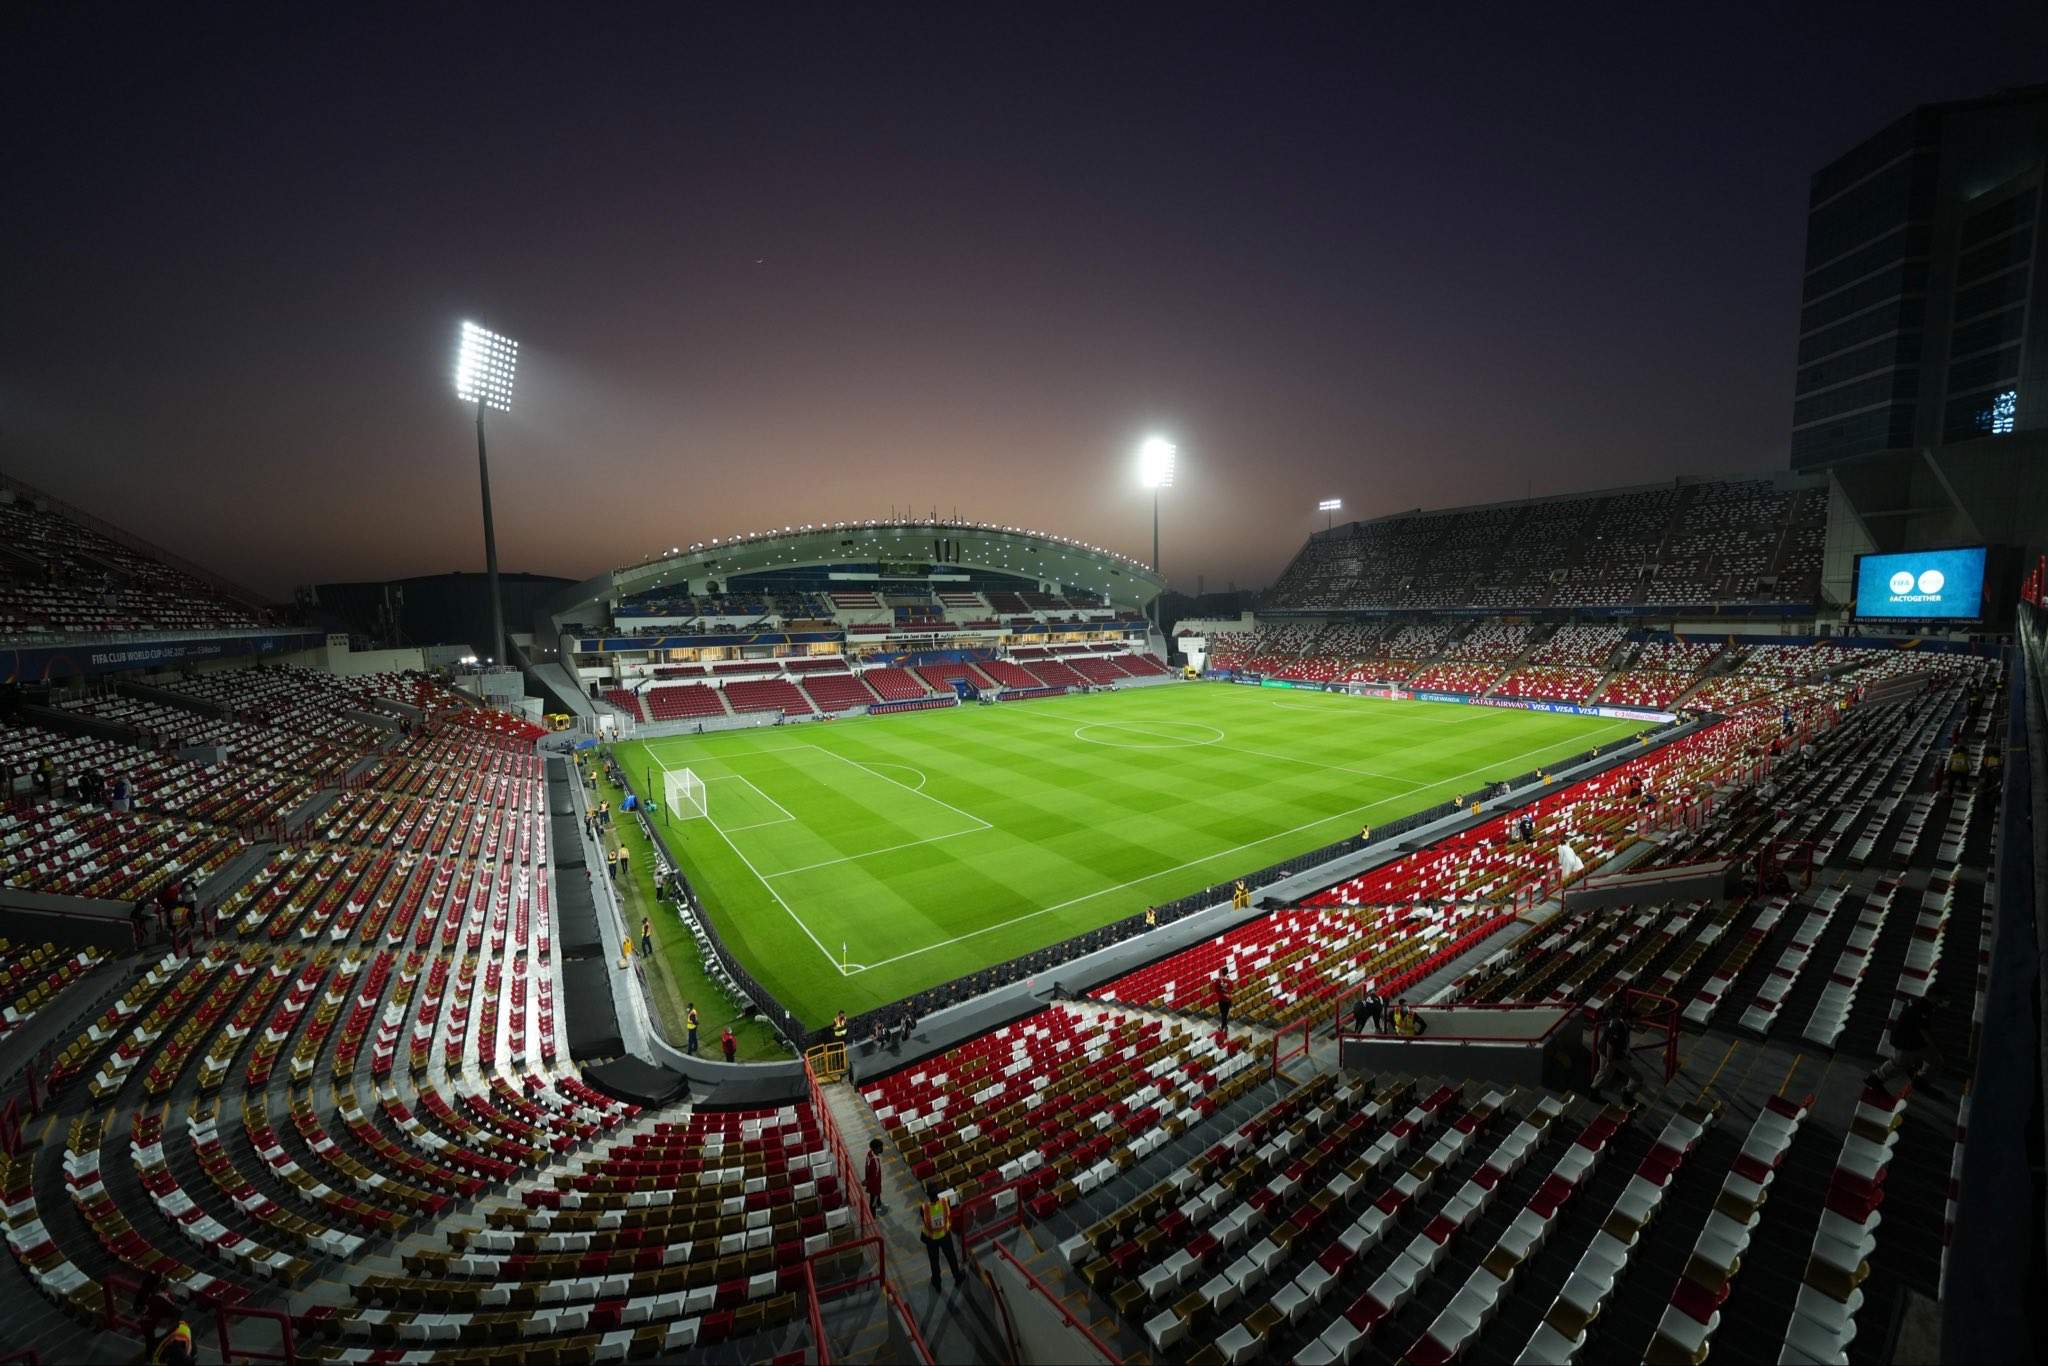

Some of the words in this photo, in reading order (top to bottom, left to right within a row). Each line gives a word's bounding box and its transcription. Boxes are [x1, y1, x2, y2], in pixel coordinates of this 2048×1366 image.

[91, 654, 109, 665] FIFA
[109, 652, 127, 663] CLUB
[127, 650, 150, 662] WORLD
[151, 648, 162, 659] CUP
[1468, 697, 1494, 706] QATAR
[1495, 700, 1529, 709] AIRWAYS
[1532, 703, 1550, 711] VISA
[1554, 705, 1573, 714] VISA
[1578, 707, 1598, 716] VISA
